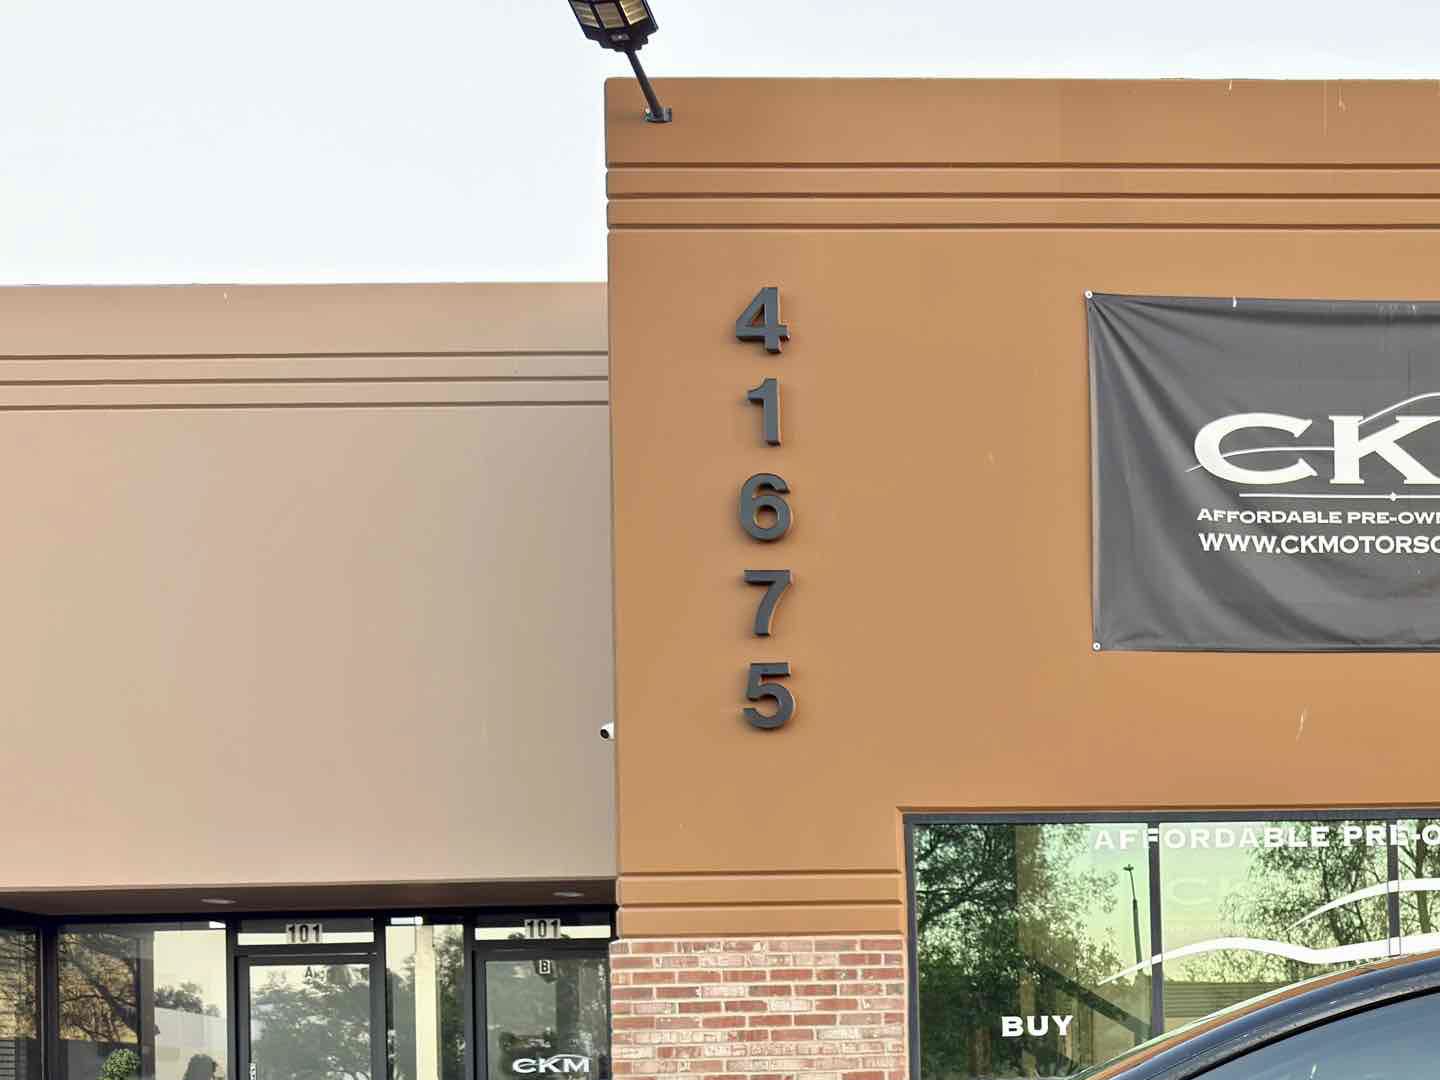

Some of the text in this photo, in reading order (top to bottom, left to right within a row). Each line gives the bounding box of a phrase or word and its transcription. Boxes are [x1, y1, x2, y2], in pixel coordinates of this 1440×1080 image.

[1197, 508, 1343, 524] AFFORDABLE
[1094, 825, 1331, 850] AFFORDABLE
[288, 924, 321, 943] 101
[526, 920, 559, 938] 101
[540, 960, 549, 974] B
[1001, 1015, 1074, 1037] BUY
[512, 1057, 590, 1073] CKM
